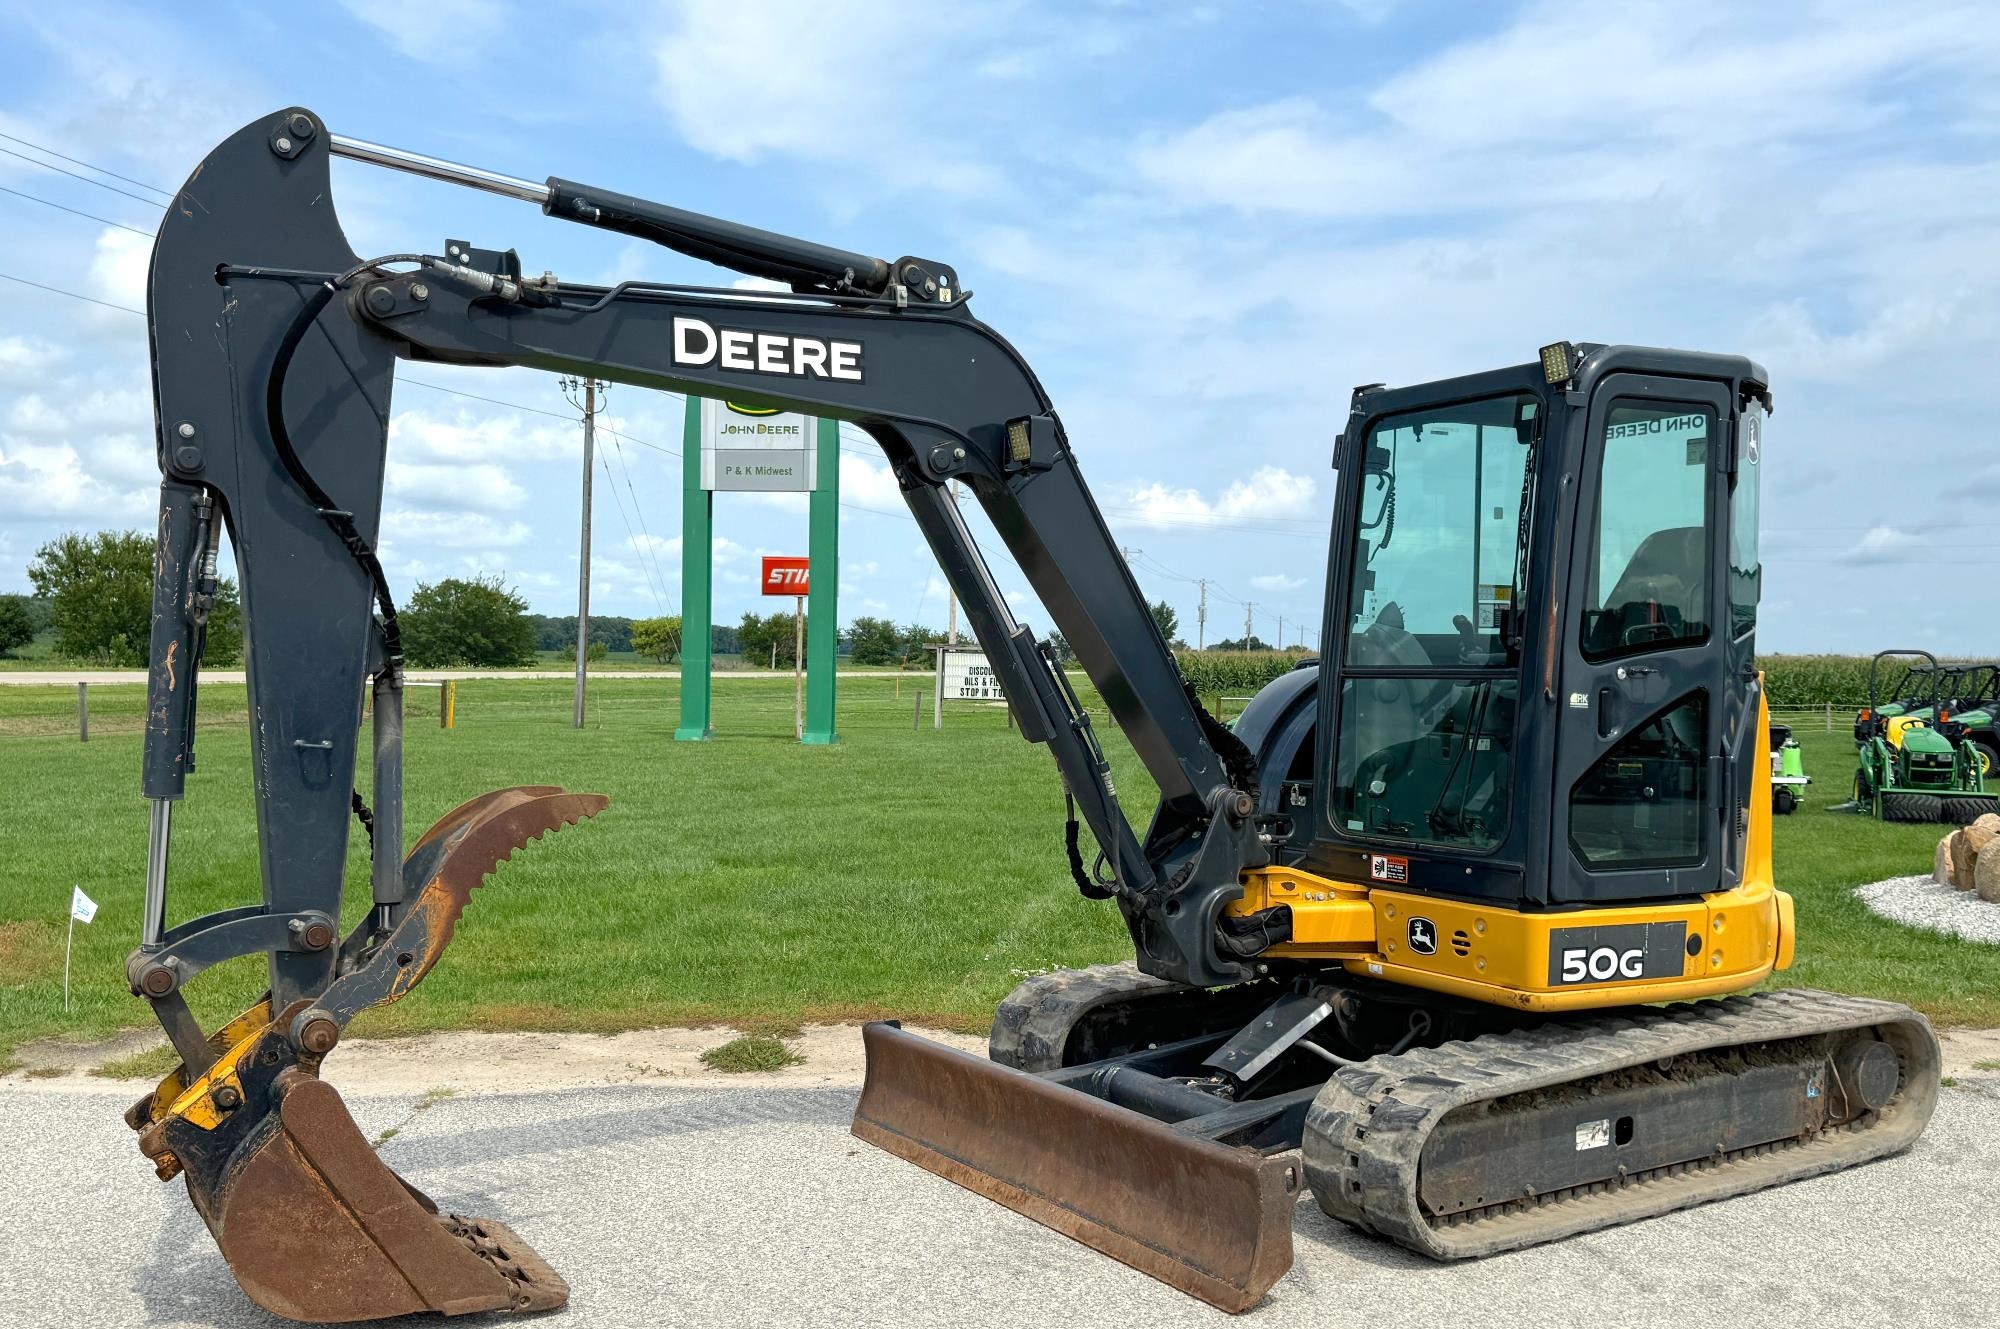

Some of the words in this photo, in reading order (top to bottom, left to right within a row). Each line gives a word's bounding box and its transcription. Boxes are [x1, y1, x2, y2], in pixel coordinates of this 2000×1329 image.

[673, 316, 862, 380] DEERE
[721, 423, 755, 435] JOHN
[757, 423, 799, 435] DEERE
[726, 466, 732, 475] P
[735, 466, 742, 475] &
[746, 466, 752, 475] K
[755, 466, 792, 476] Midwest
[969, 666, 993, 675] DISCOU
[964, 677, 979, 686] OILS
[982, 677, 987, 687] &
[960, 687, 980, 697] STOP
[981, 688, 989, 697] IN
[1562, 947, 1643, 982] 50G
